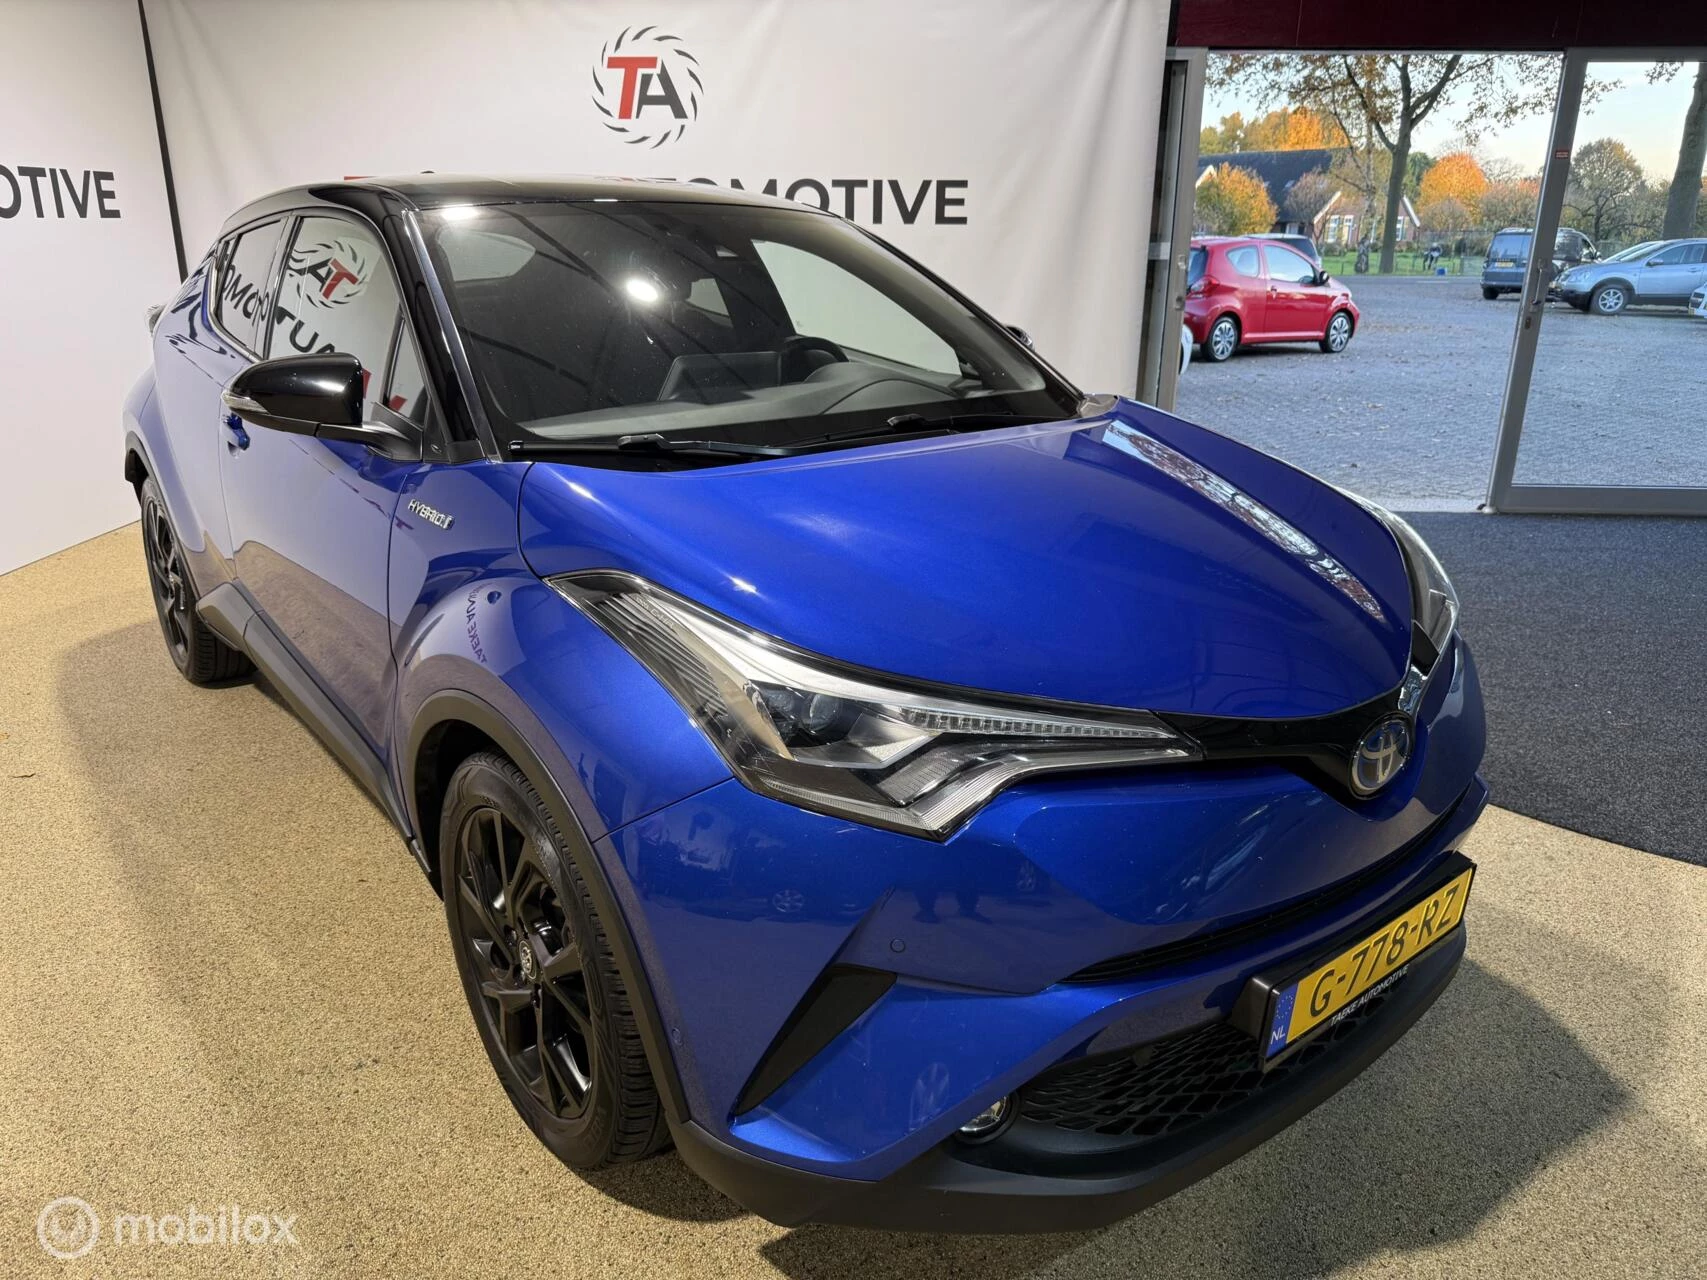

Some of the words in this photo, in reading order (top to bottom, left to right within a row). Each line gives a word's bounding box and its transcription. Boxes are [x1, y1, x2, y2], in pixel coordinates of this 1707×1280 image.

[607, 56, 689, 120] TA
[407, 499, 446, 527] HYBRID
[1310, 884, 1459, 1018] G-778-RZ
[1358, 963, 1410, 1007] AUTOMOTIVE
[1270, 1026, 1286, 1045] NL
